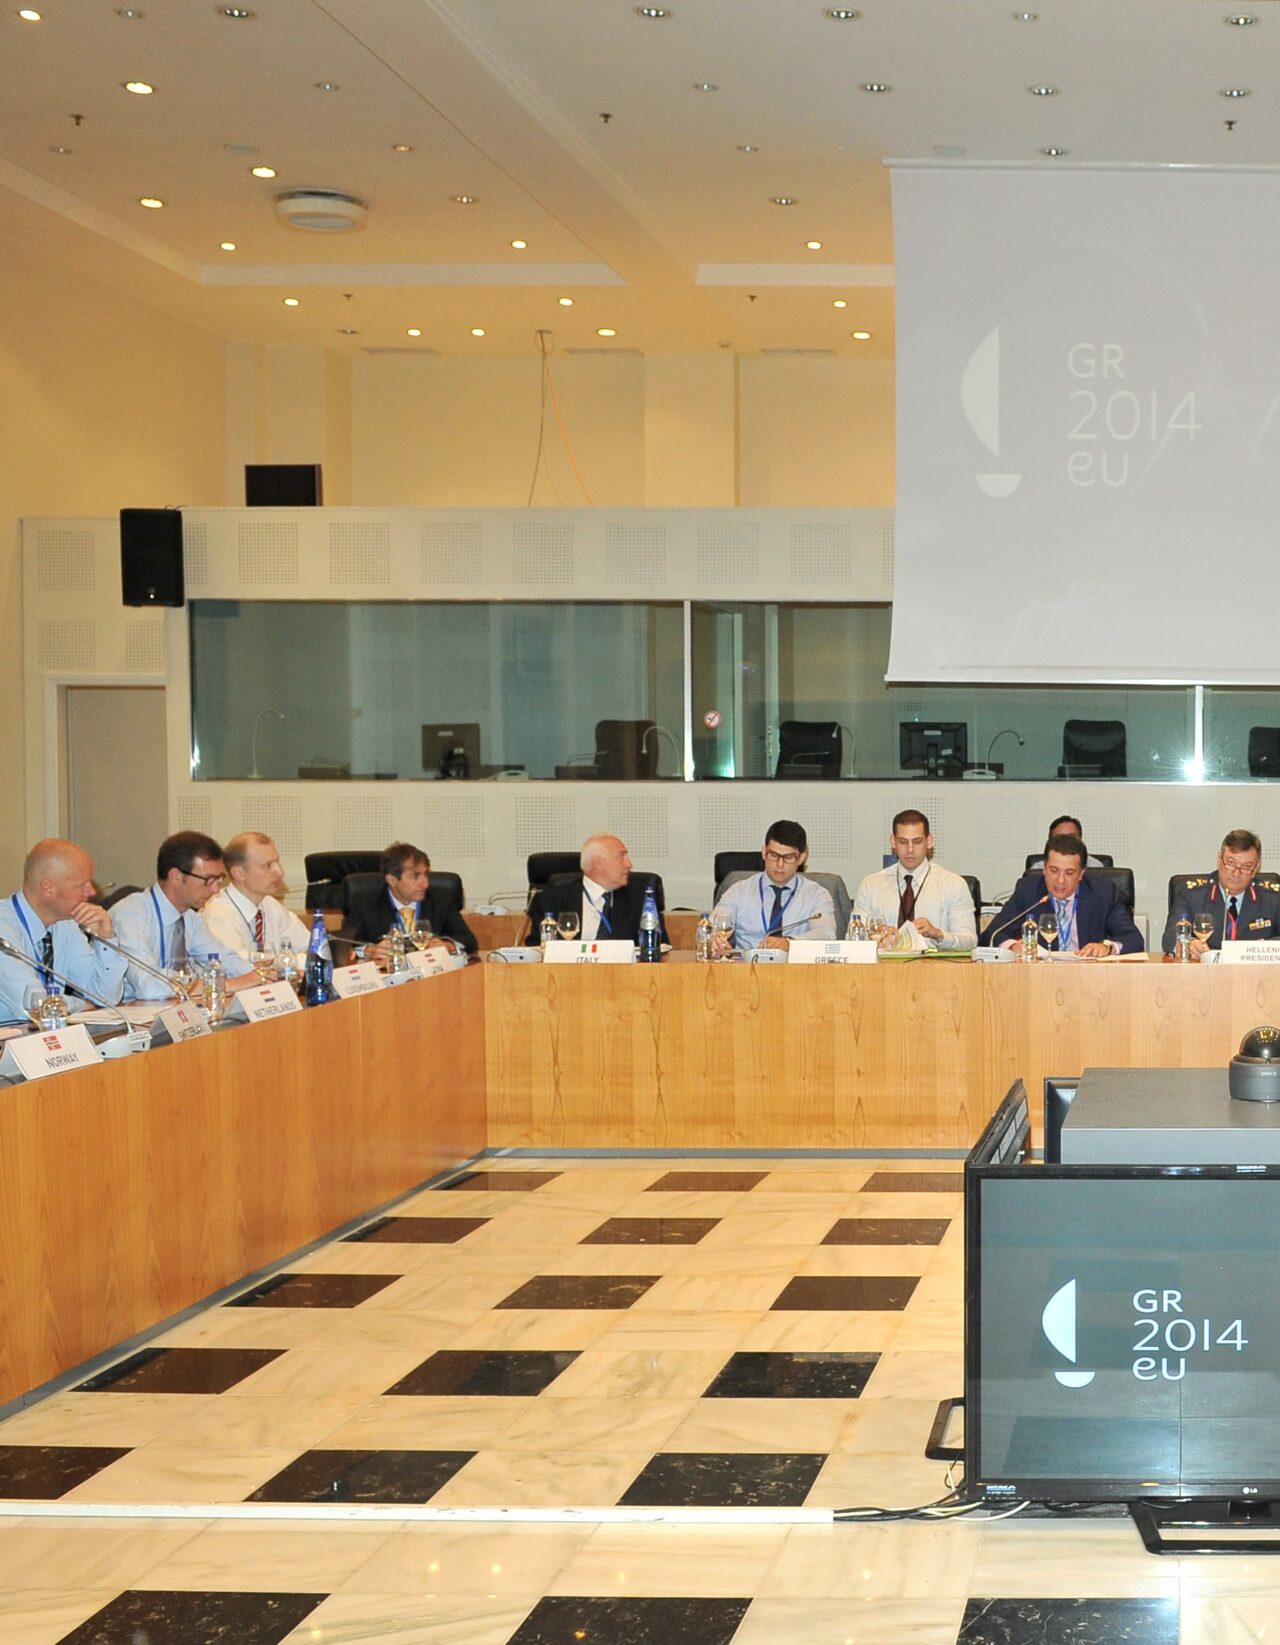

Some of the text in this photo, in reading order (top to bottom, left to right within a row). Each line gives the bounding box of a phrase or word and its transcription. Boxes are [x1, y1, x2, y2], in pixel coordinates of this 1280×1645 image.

[1067, 342, 1126, 379] GR
[1066, 389, 1204, 441] 2014
[1067, 450, 1129, 487] eu
[814, 956, 849, 964] GREECE
[253, 1001, 298, 1019] NETHERLANDS
[44, 1051, 80, 1070] NORWAY
[1132, 1289, 1184, 1313] GR
[1132, 1318, 1249, 1352] 2014
[1132, 1357, 1186, 1380] eu
